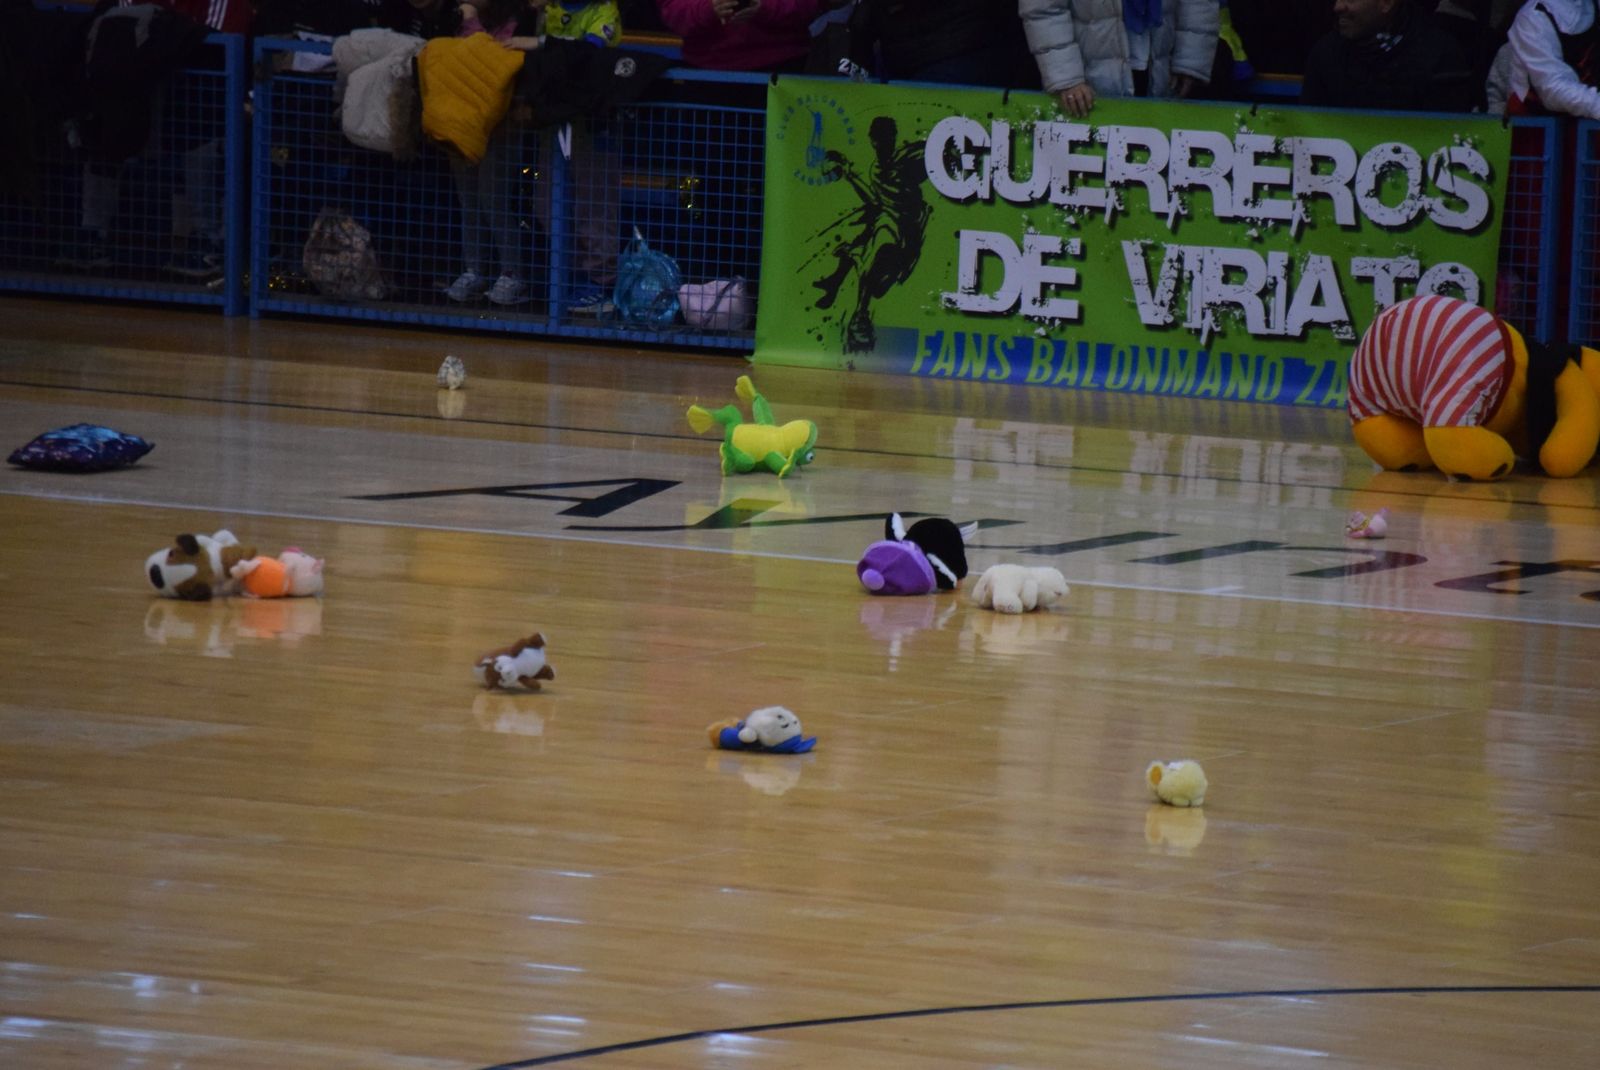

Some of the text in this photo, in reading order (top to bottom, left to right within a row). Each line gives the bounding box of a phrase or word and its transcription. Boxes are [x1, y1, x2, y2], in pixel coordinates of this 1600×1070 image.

[924, 115, 1490, 231] GUERREROS
[941, 229, 1081, 320] DE
[911, 330, 1015, 380] FANS
[1025, 337, 1284, 400] BALONMANO
